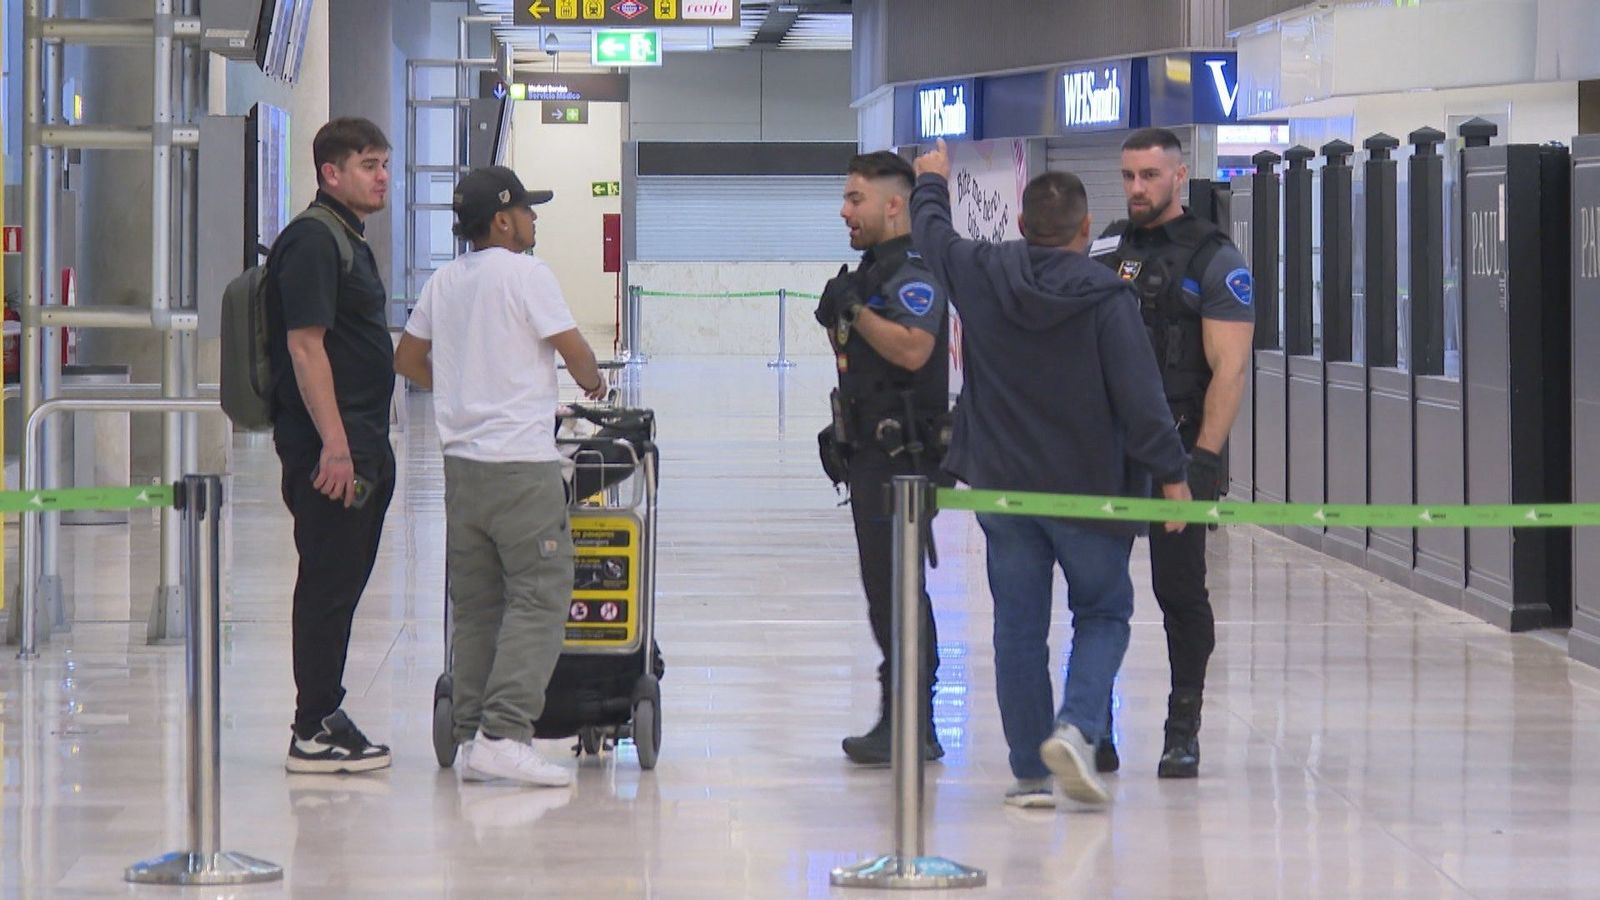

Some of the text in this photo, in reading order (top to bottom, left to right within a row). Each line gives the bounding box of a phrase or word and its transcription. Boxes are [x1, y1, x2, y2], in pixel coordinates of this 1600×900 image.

[687, 0, 728, 16] renfe
[920, 85, 967, 138] WHSmith
[1064, 67, 1120, 127] WHSmith
[1472, 210, 1500, 277] PAUL
